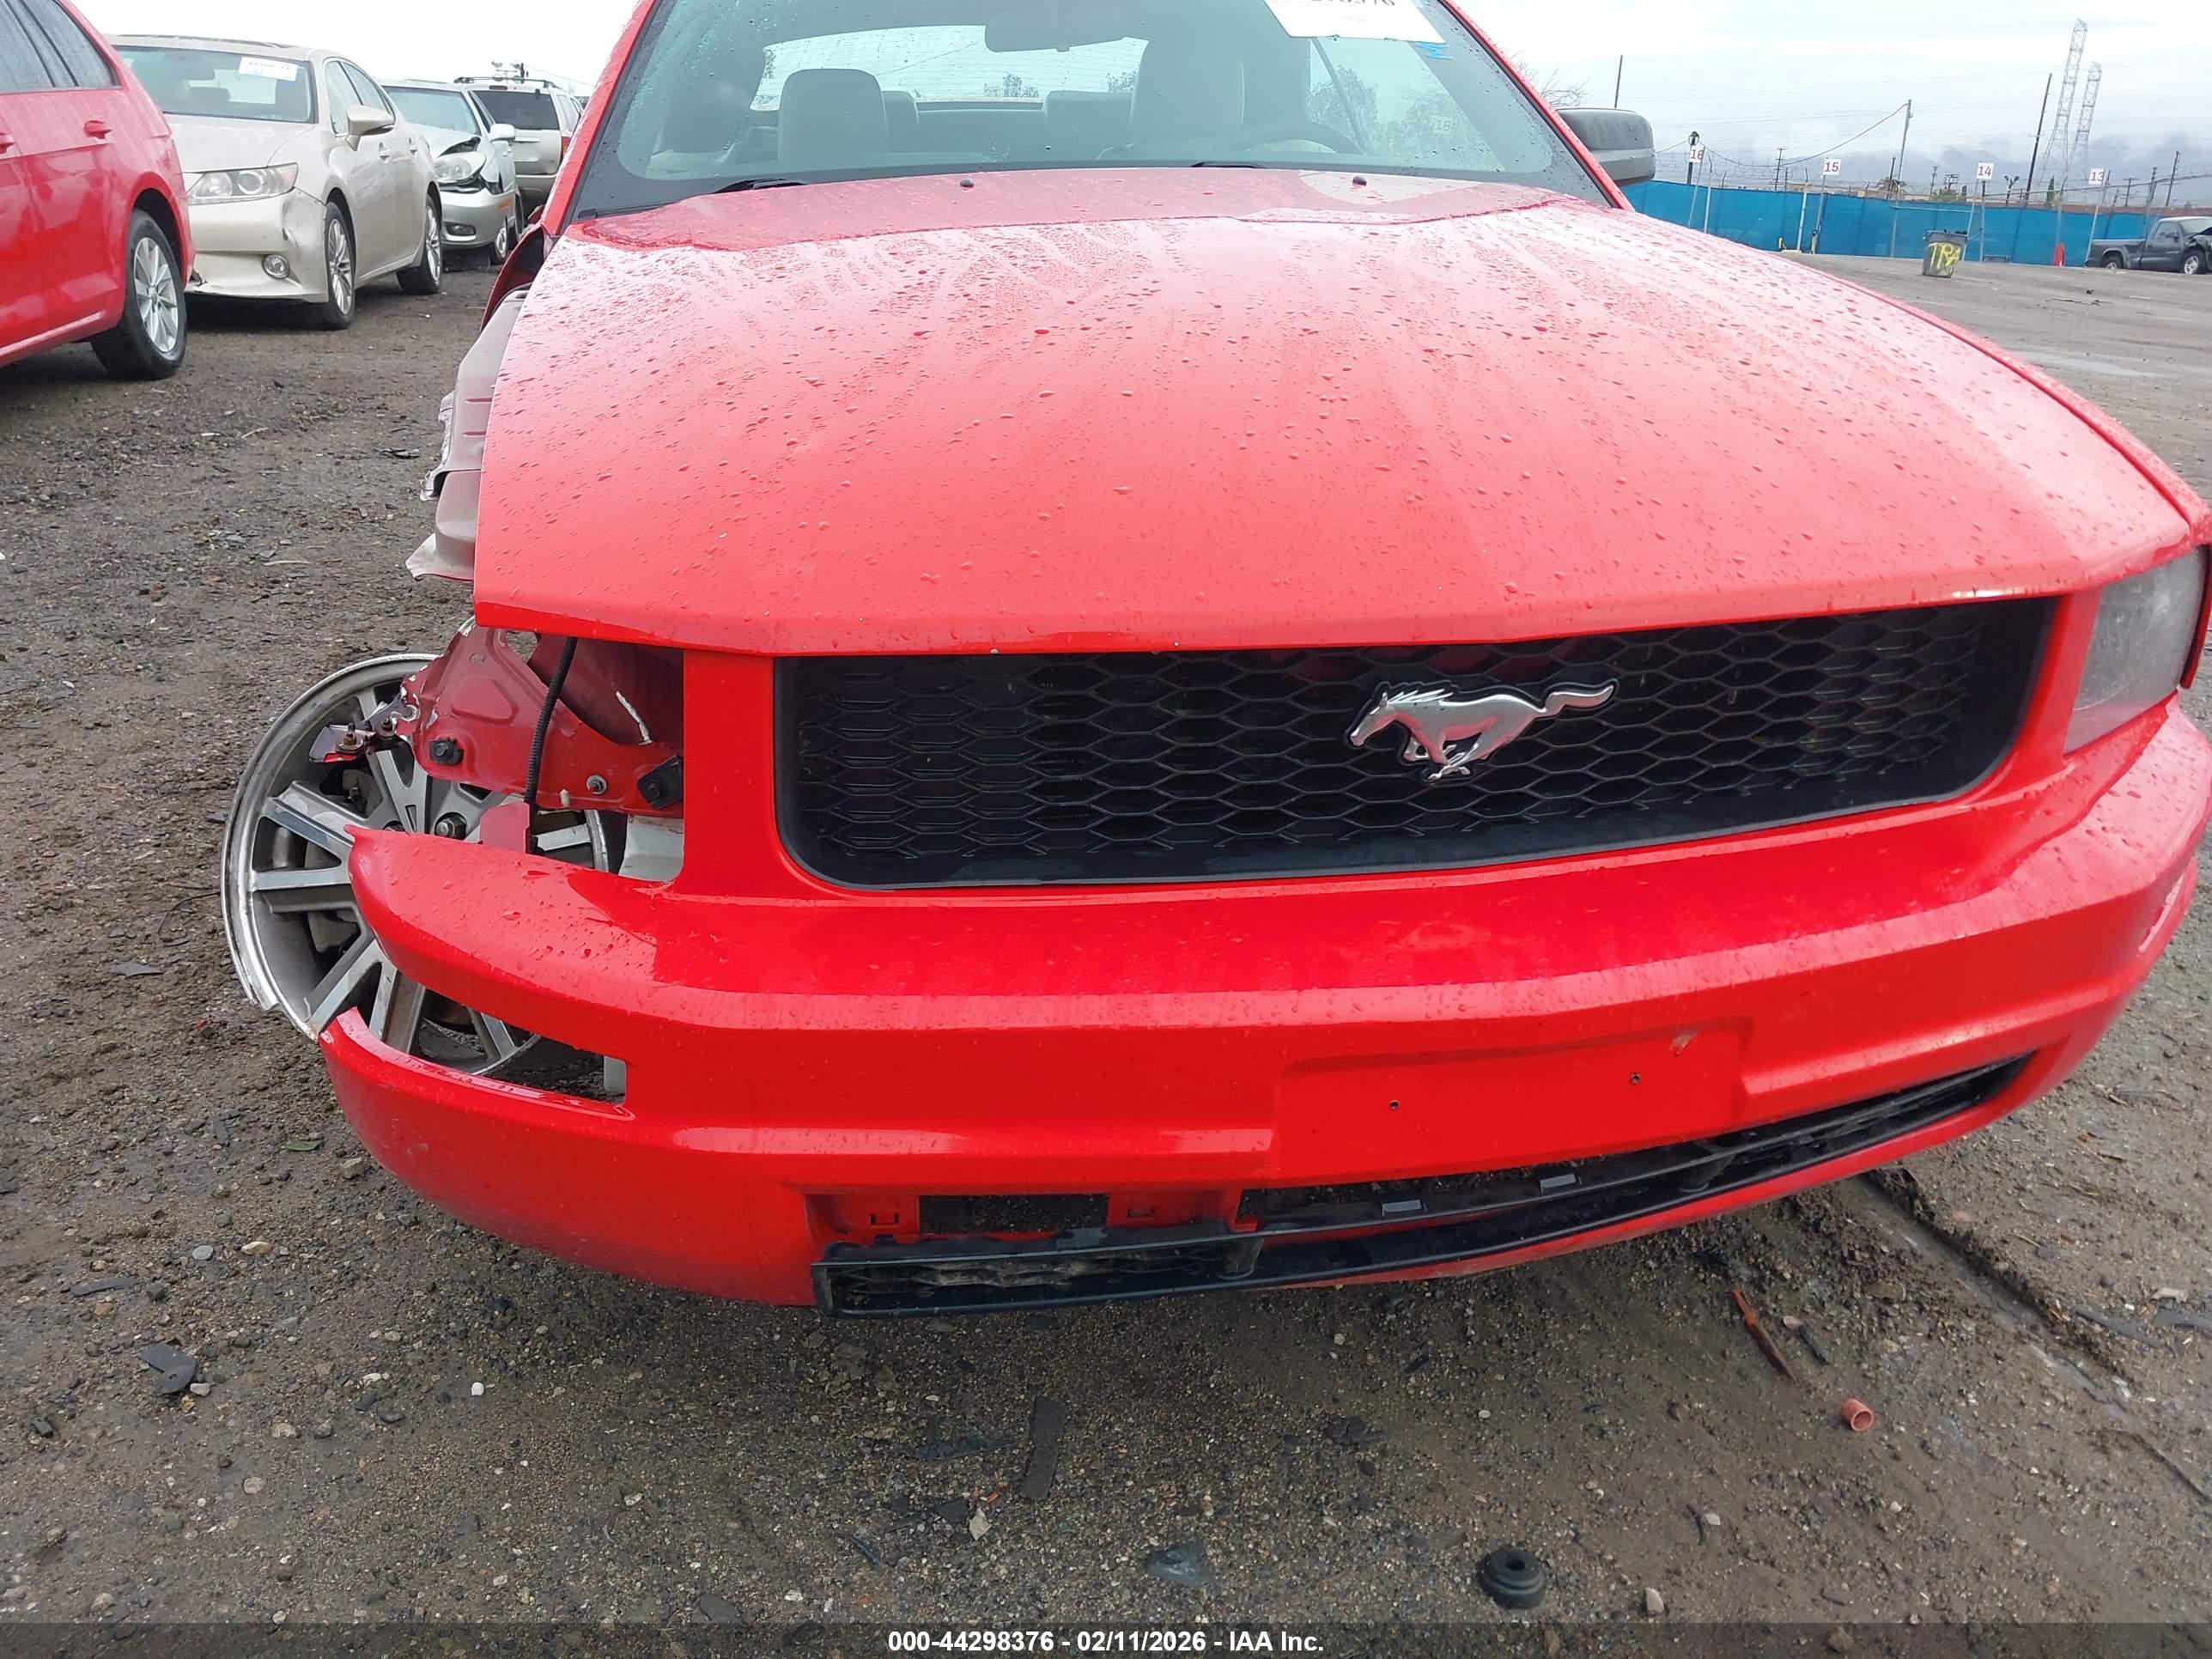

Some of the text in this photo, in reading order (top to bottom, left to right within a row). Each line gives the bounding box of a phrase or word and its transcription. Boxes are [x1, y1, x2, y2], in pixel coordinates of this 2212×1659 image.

[1825, 161, 1839, 173] 15
[1978, 166, 1992, 177] 14
[2090, 171, 2104, 181] 13
